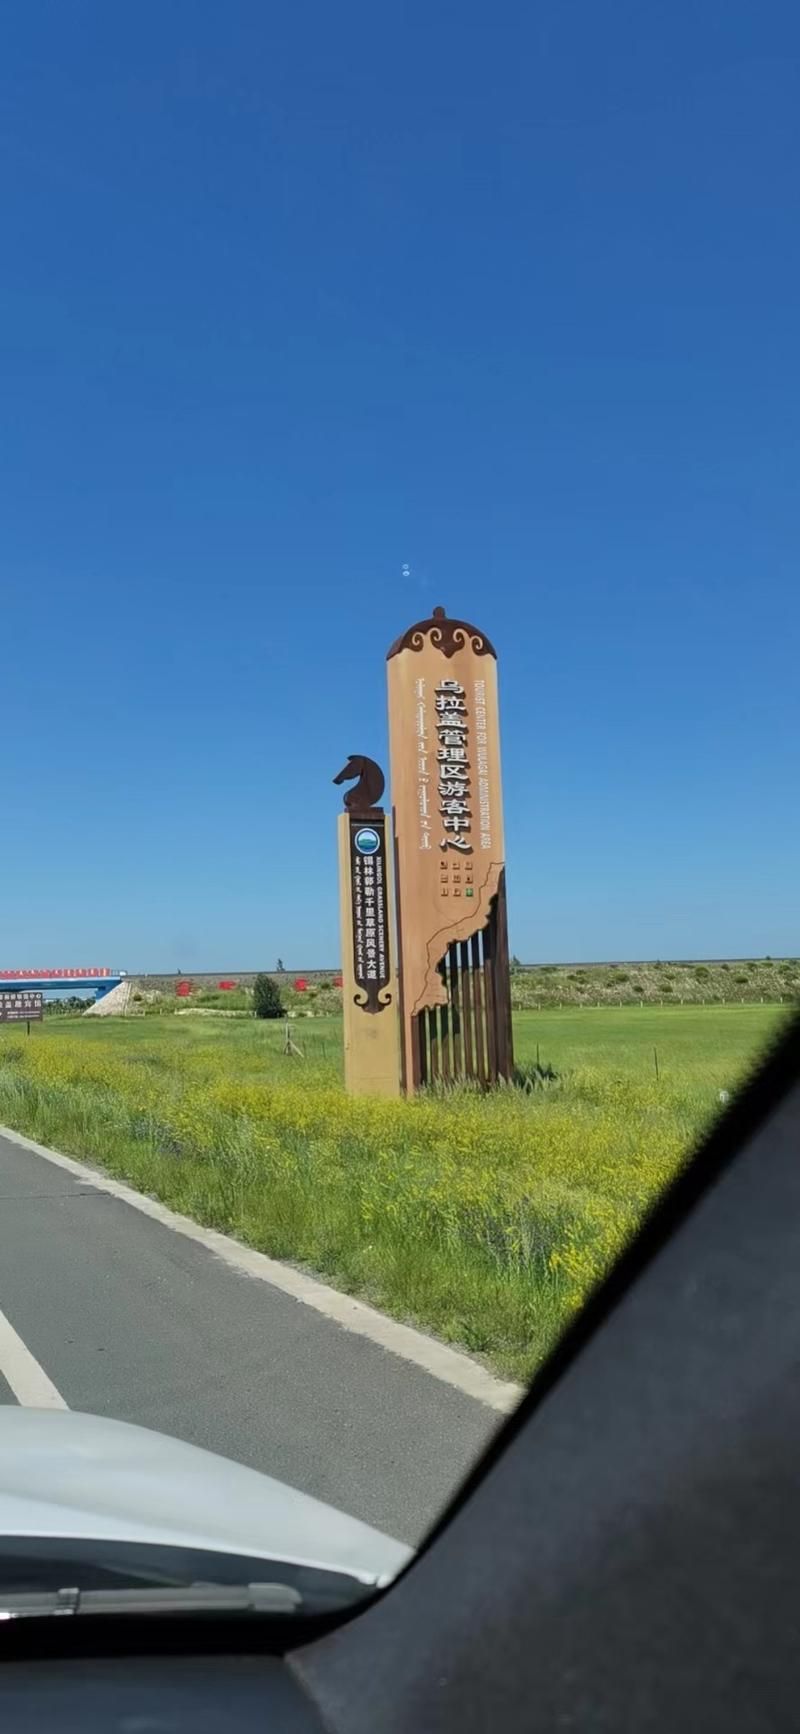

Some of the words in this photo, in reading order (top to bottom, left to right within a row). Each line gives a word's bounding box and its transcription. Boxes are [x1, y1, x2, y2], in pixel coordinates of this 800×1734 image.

[474, 680, 485, 705] TOURIST
[475, 707, 487, 730] CENTER
[476, 731, 487, 745] FOR
[435, 679, 472, 851] 乌拉盖管理区游客中心
[477, 746, 488, 777] WULAGAI
[478, 777, 490, 831] ADMINISTRATION
[480, 833, 492, 849] AREA
[363, 855, 377, 979] 锡林郭勒千里草原风景大道
